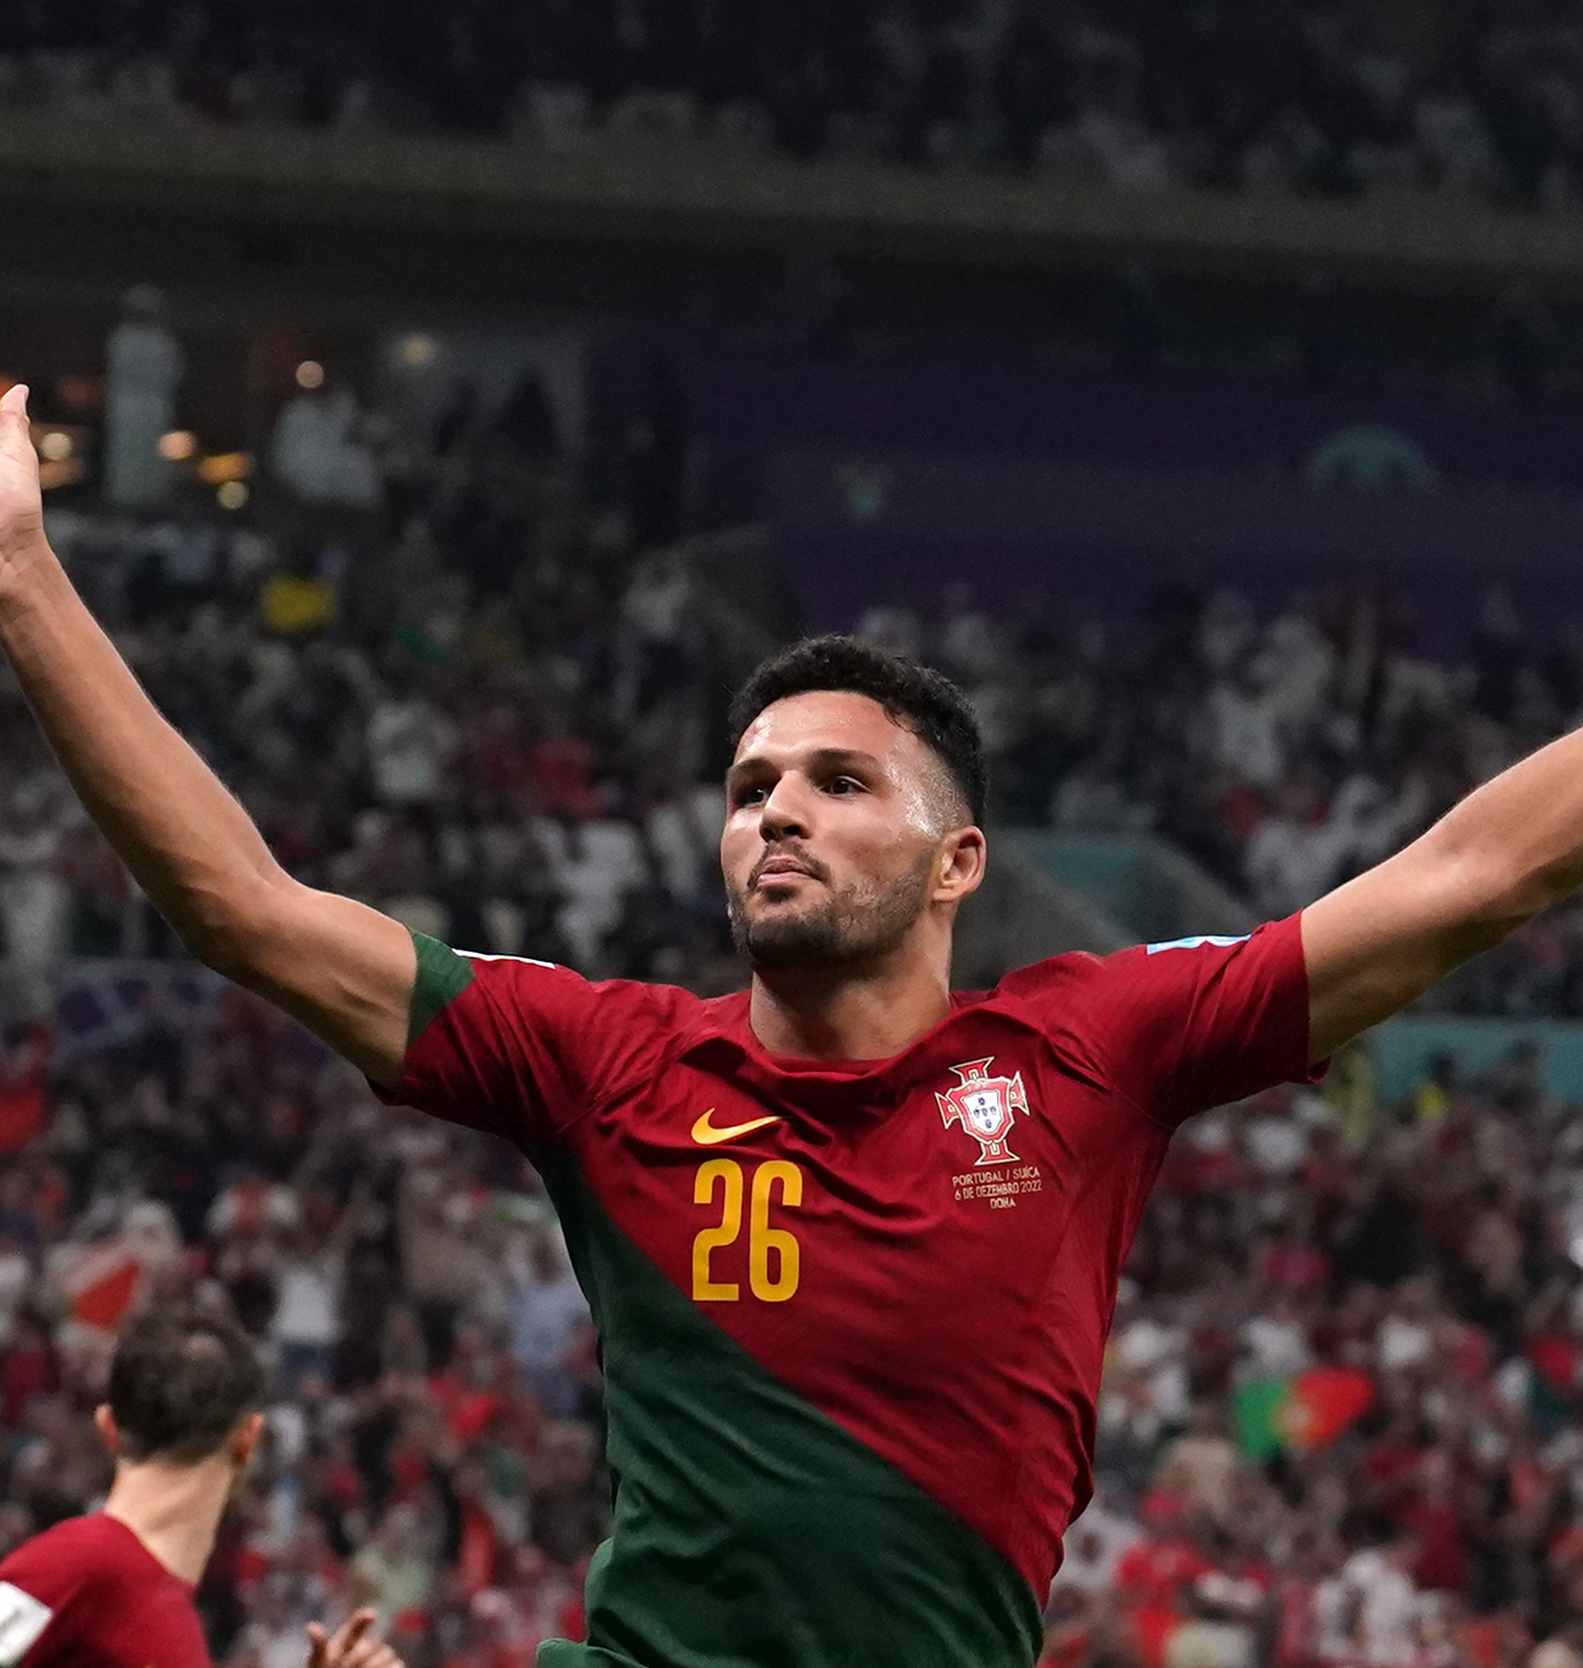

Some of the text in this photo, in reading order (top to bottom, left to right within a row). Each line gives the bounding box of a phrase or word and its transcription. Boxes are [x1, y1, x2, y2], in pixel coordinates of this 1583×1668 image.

[952, 1171, 1004, 1187] PORTUGAL
[954, 1179, 1042, 1200] 6 DE DEZEMBRO 2022
[990, 1197, 1016, 1209] DOHA
[692, 1158, 803, 1302] 26
